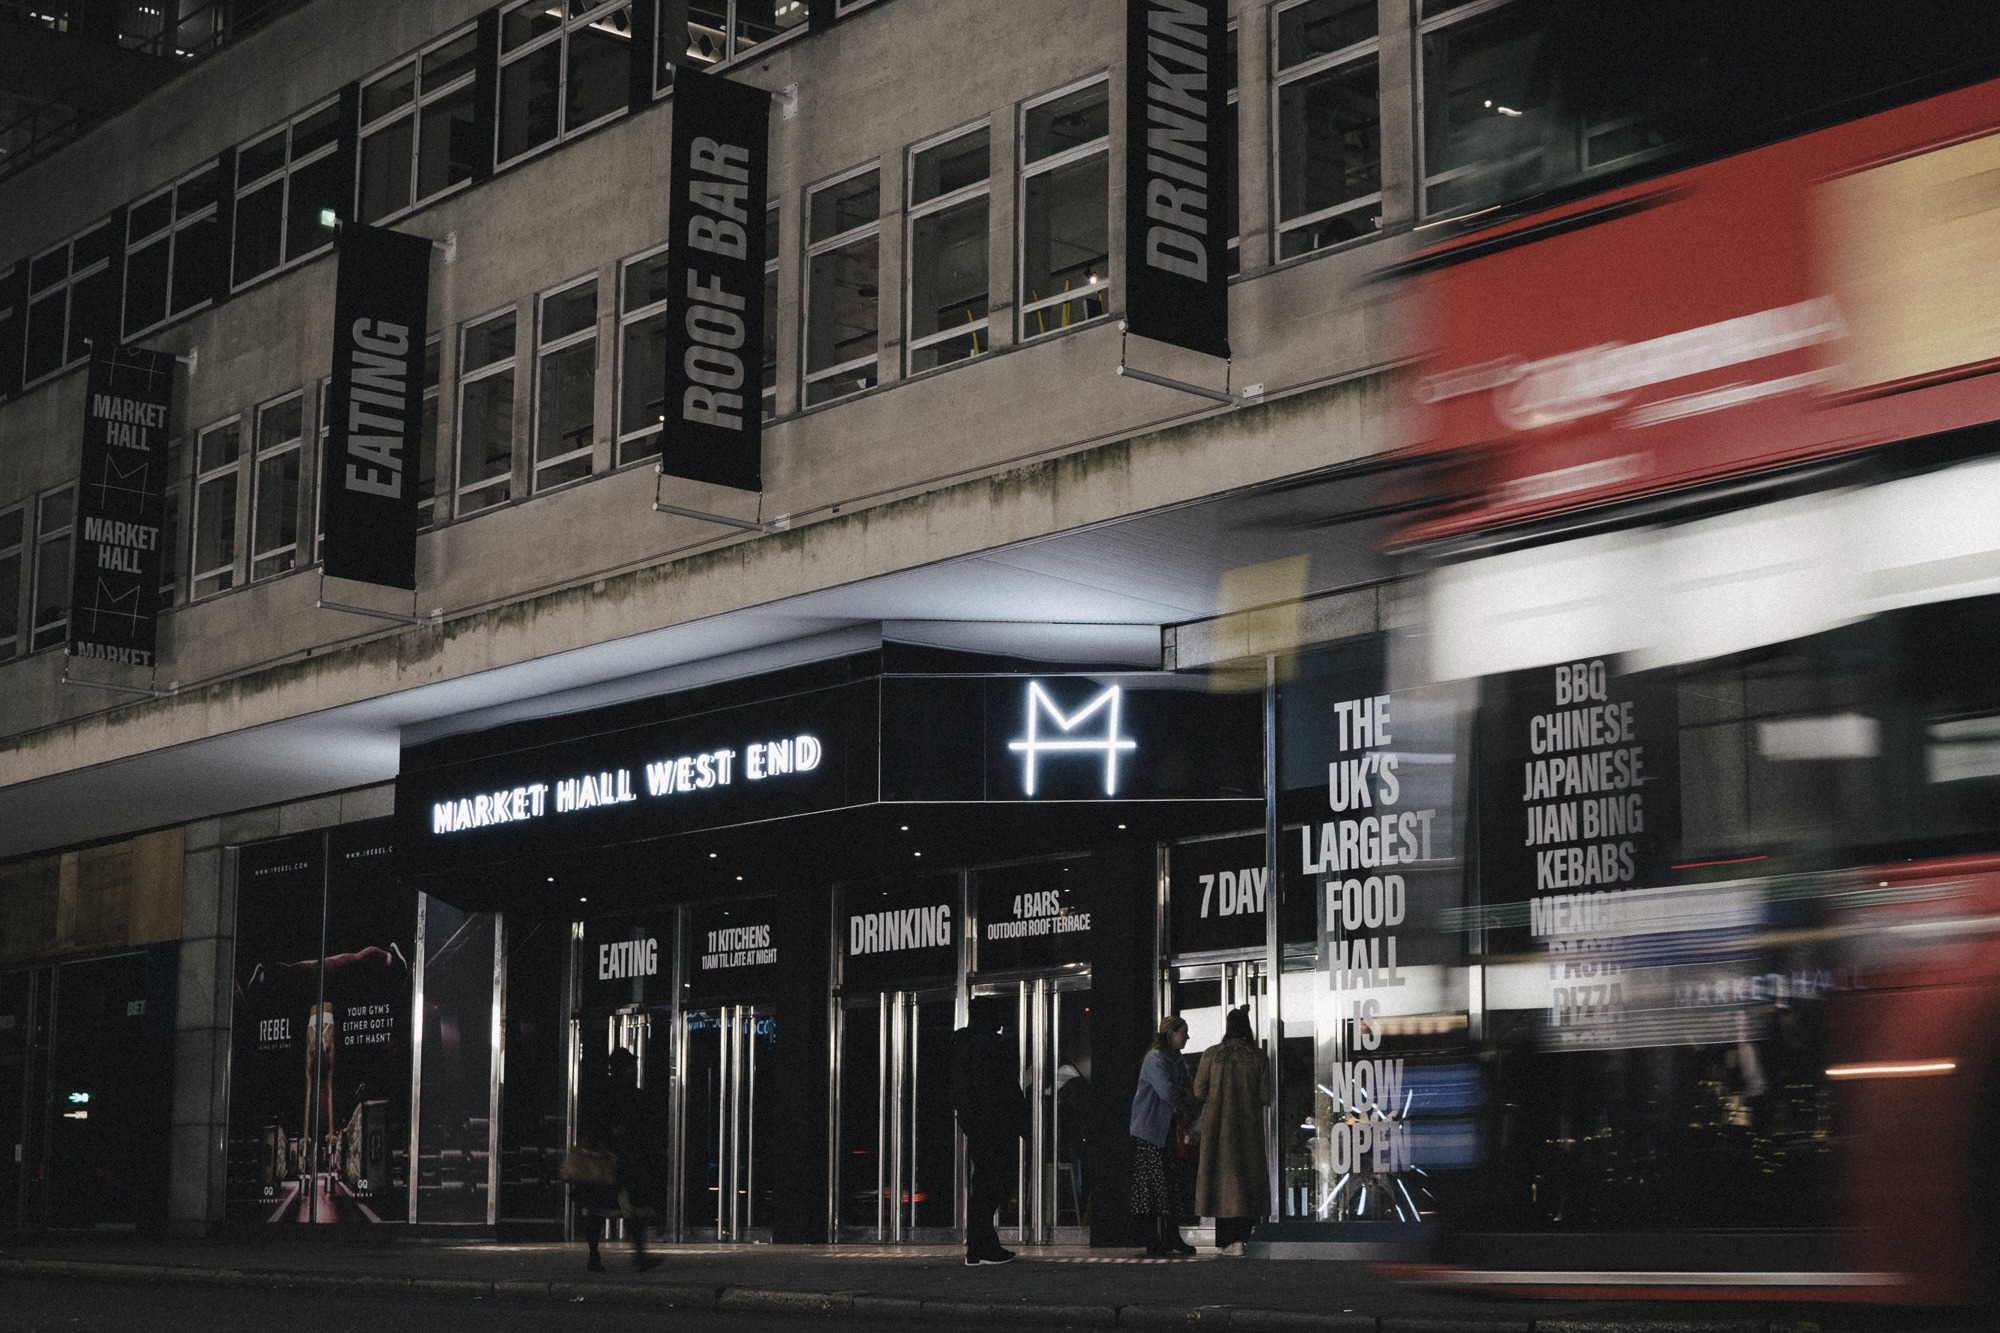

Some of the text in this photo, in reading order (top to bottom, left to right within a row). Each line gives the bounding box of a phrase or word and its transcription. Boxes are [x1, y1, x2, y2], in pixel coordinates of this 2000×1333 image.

[1147, 0, 1207, 283] DRINKIN
[683, 136, 749, 430] ROOF BAR
[92, 394, 167, 429] MARKET
[345, 317, 410, 499] EATING
[105, 421, 151, 451] HALL
[84, 516, 159, 551] MARKET
[97, 544, 142, 574] HALL
[1555, 659, 1609, 706] BBQ
[1333, 694, 1392, 752] THE
[1530, 701, 1636, 756] CHINESE
[433, 734, 823, 834] MARKET HALL WEST END
[1328, 753, 1400, 813] UK'S
[1523, 746, 1645, 802] JAPANESE
[1301, 808, 1436, 876] LARGEST
[1525, 793, 1645, 847] JIAN BING
[1537, 841, 1636, 890] KEBABS
[1013, 889, 1060, 919] 4 BARS
[1198, 866, 1268, 919] 7 DAY
[1325, 874, 1406, 932] FOOD
[708, 924, 770, 953] 11 KITCHENS
[850, 904, 951, 956] DRINKING
[987, 913, 1091, 940] OUTDOOR ROOF TERRACE
[598, 937, 658, 980] EATING
[730, 950, 747, 967] LATE
[747, 950, 756, 965] AT
[755, 948, 778, 965] NIGHT
[1328, 936, 1405, 992] HALL
[343, 1018, 394, 1031] EITHER GOT IT
[346, 1004, 390, 1017] YOUR GYM'S
[1353, 999, 1382, 1051] IS
[1552, 983, 1624, 1027] PIZZA
[344, 1032, 391, 1046] OR IT HASN'T
[1332, 1058, 1404, 1114] NOW
[1330, 1120, 1411, 1175] OPEN
[263, 1186, 274, 1196] GQ
[357, 1179, 368, 1190] GQ
